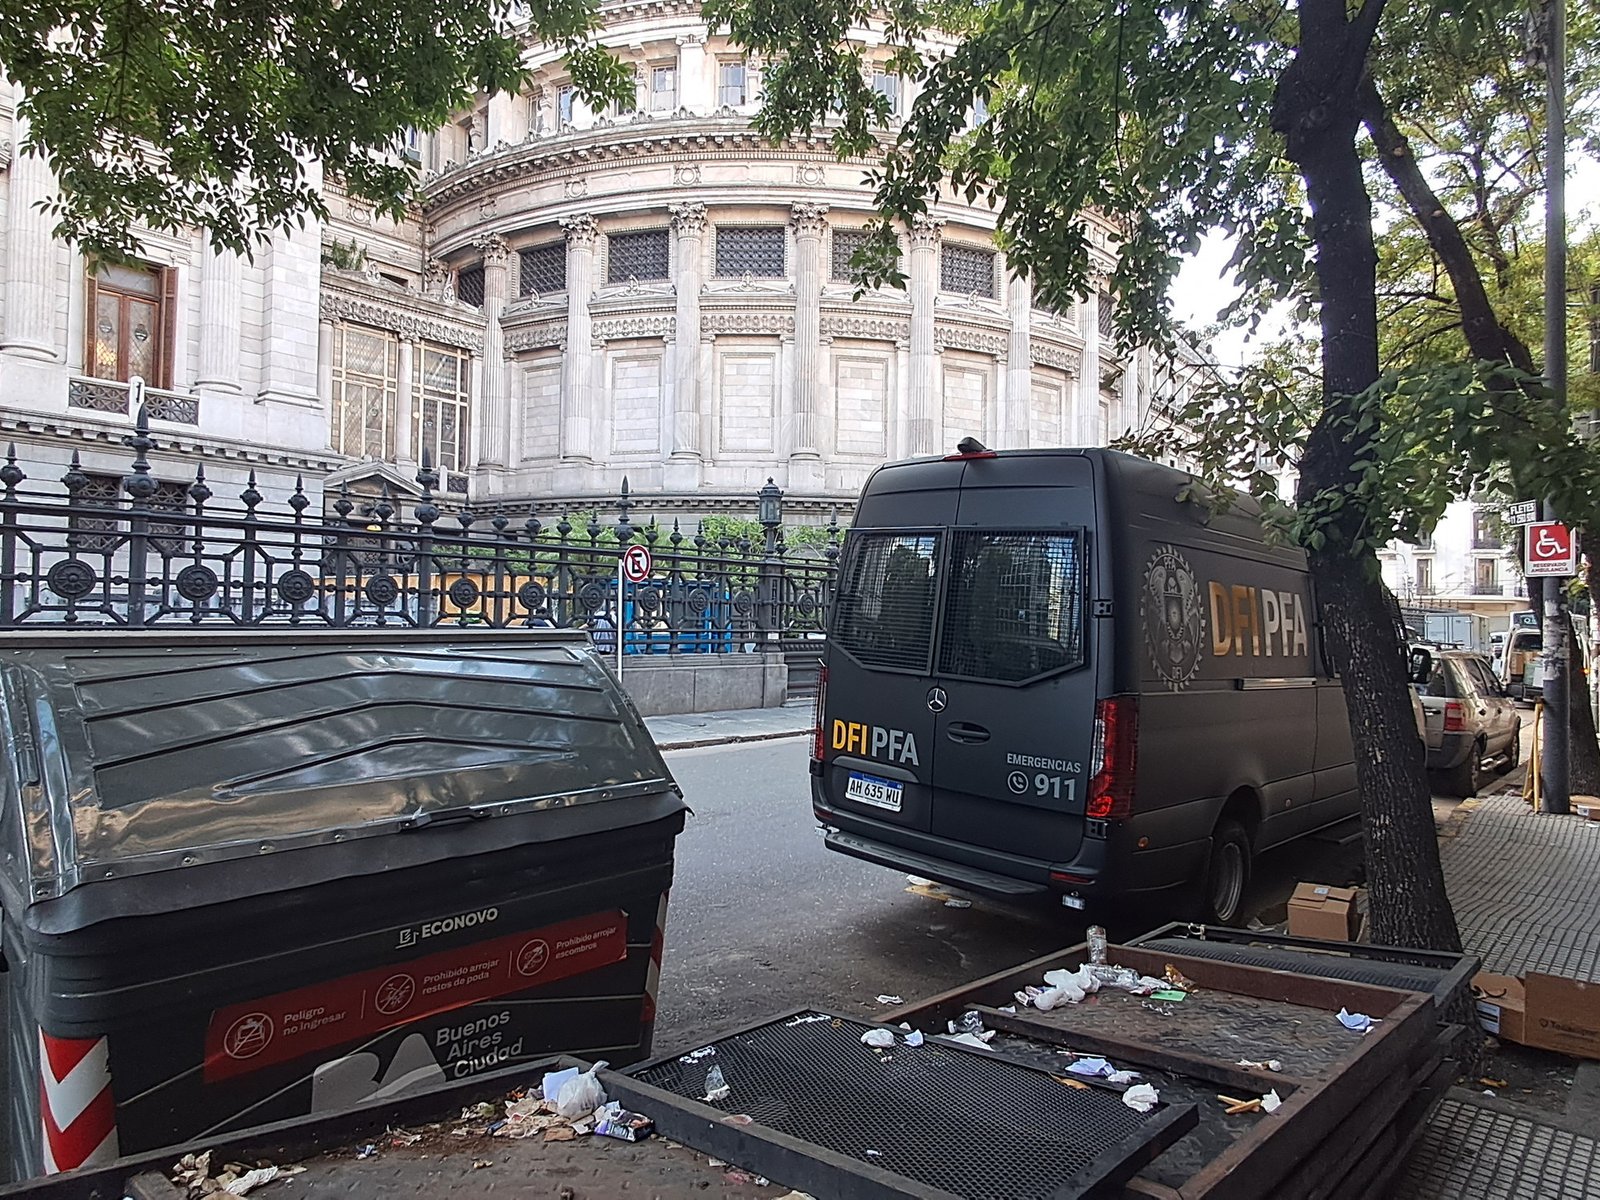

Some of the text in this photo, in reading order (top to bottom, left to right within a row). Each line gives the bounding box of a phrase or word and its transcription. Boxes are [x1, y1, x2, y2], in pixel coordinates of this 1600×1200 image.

[1510, 502, 1535, 515] FLETES
[631, 552, 643, 573] E
[832, 719, 919, 766] DFI PFA
[1007, 753, 1081, 774] EMERGENCIAS
[849, 779, 863, 794] AH
[864, 783, 883, 799] 635
[1034, 773, 1075, 801] 911
[421, 907, 499, 938] ECONOVO
[555, 926, 616, 950] Prohibido arrojar
[555, 942, 598, 959] escombros
[422, 971, 490, 995] restos de poda
[423, 958, 500, 984] Prohibido arrojar
[283, 1011, 347, 1036] no ingresar
[284, 1006, 325, 1024] Peligro
[436, 1011, 510, 1047] Buenos
[446, 1030, 502, 1062] Aires
[453, 1037, 524, 1079] Ciudad
